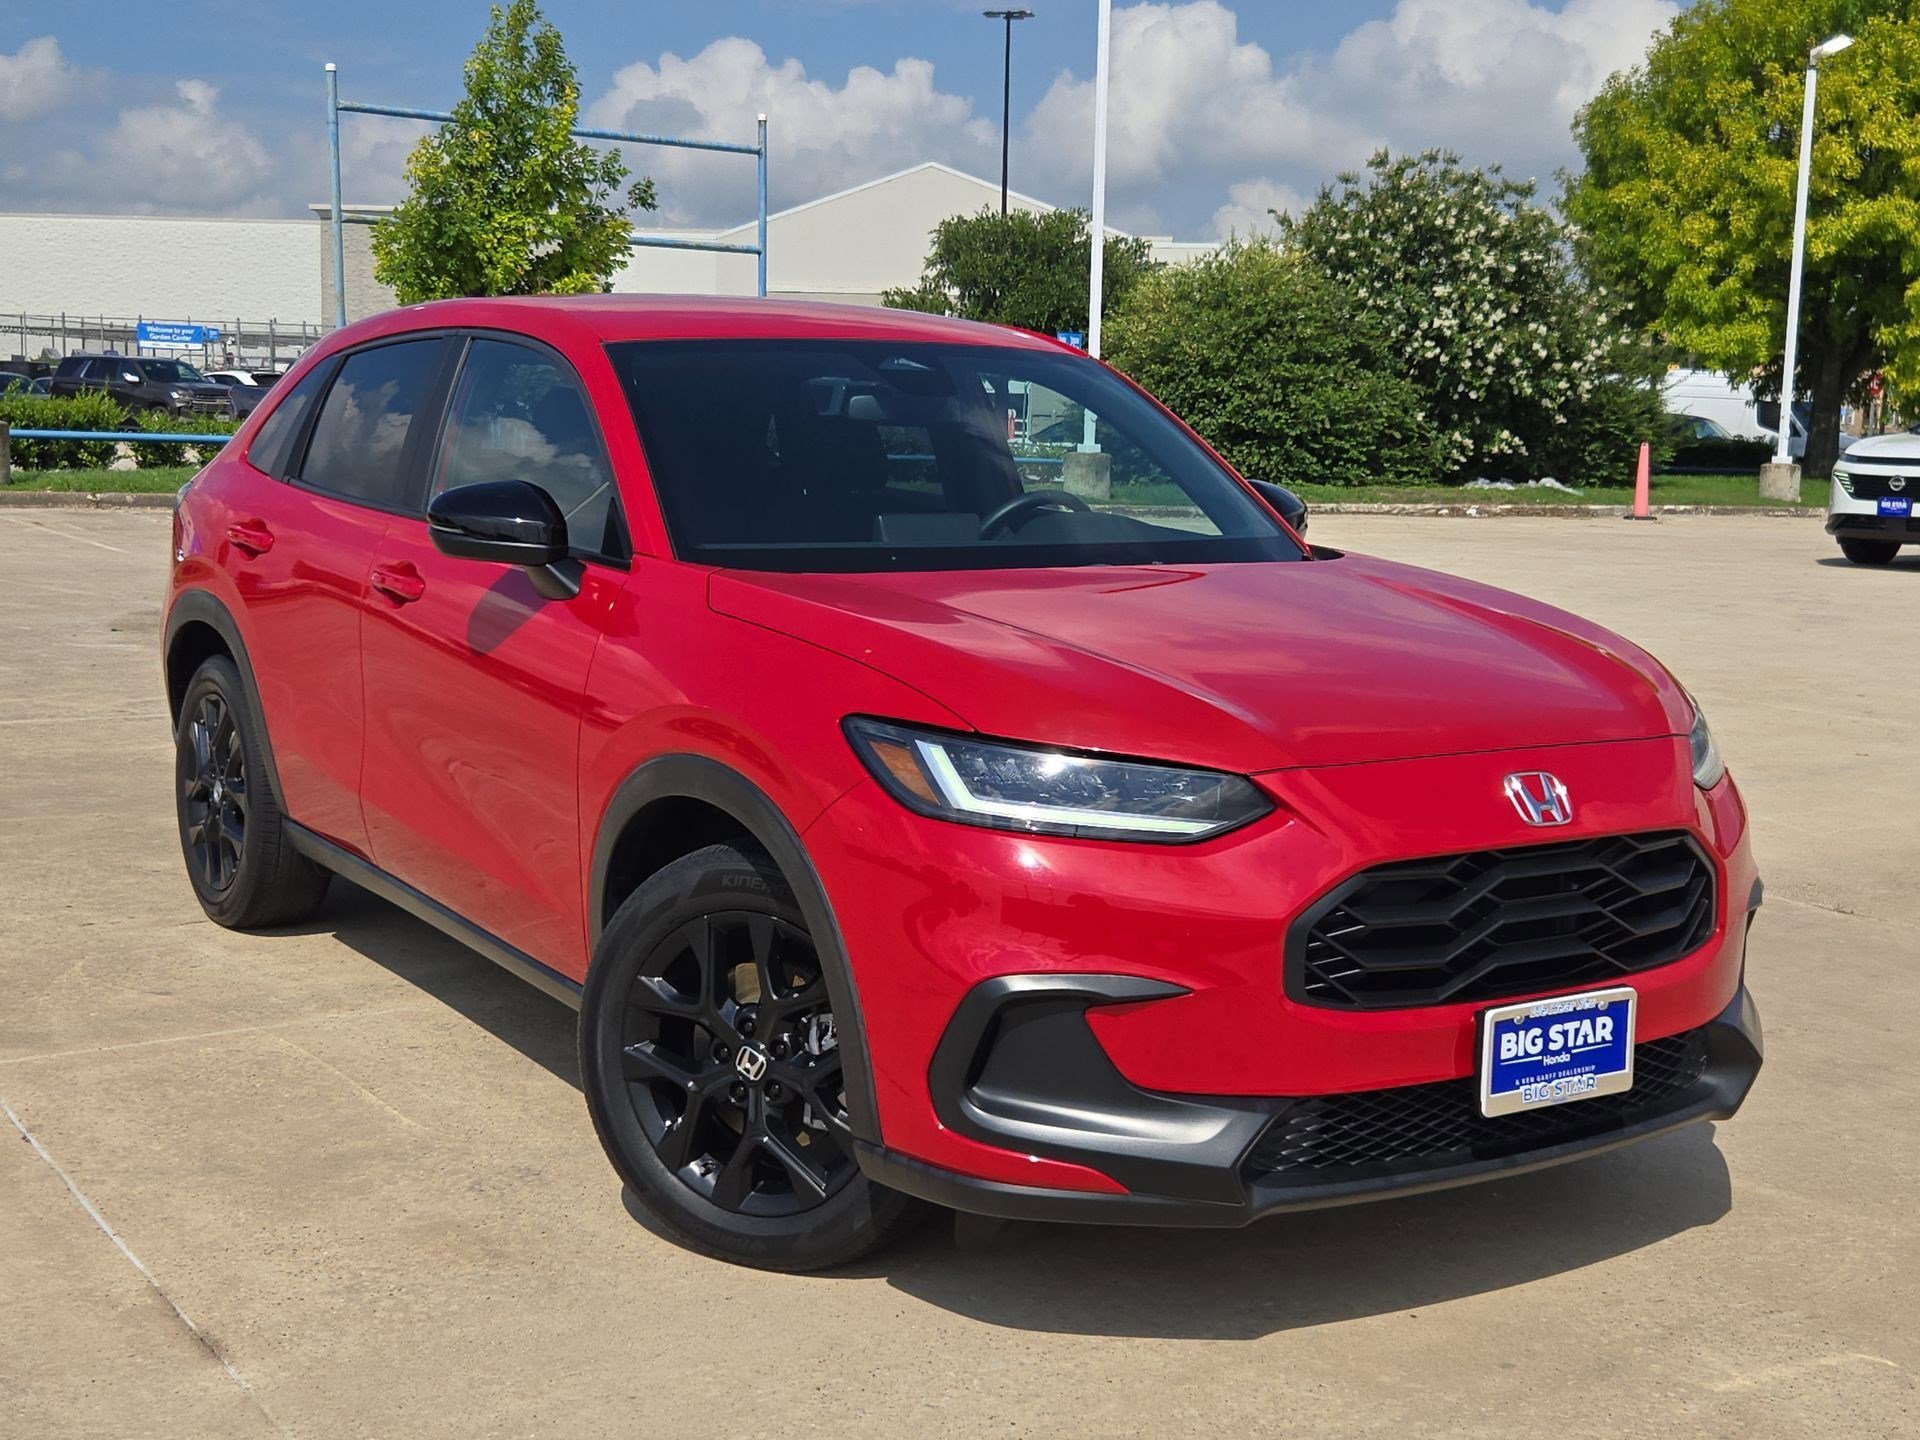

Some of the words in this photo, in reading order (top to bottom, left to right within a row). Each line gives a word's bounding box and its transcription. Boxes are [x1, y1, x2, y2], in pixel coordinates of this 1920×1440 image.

[146, 325, 173, 333] Welcome
[182, 328, 195, 336] your
[1500, 1027, 1544, 1060] BIG
[1548, 1016, 1614, 1051] STAR
[1543, 1052, 1571, 1066] Honda
[1558, 1065, 1596, 1078] DEALERSHIP
[1523, 1083, 1549, 1101] BIG
[1554, 1075, 1597, 1096] STAR
